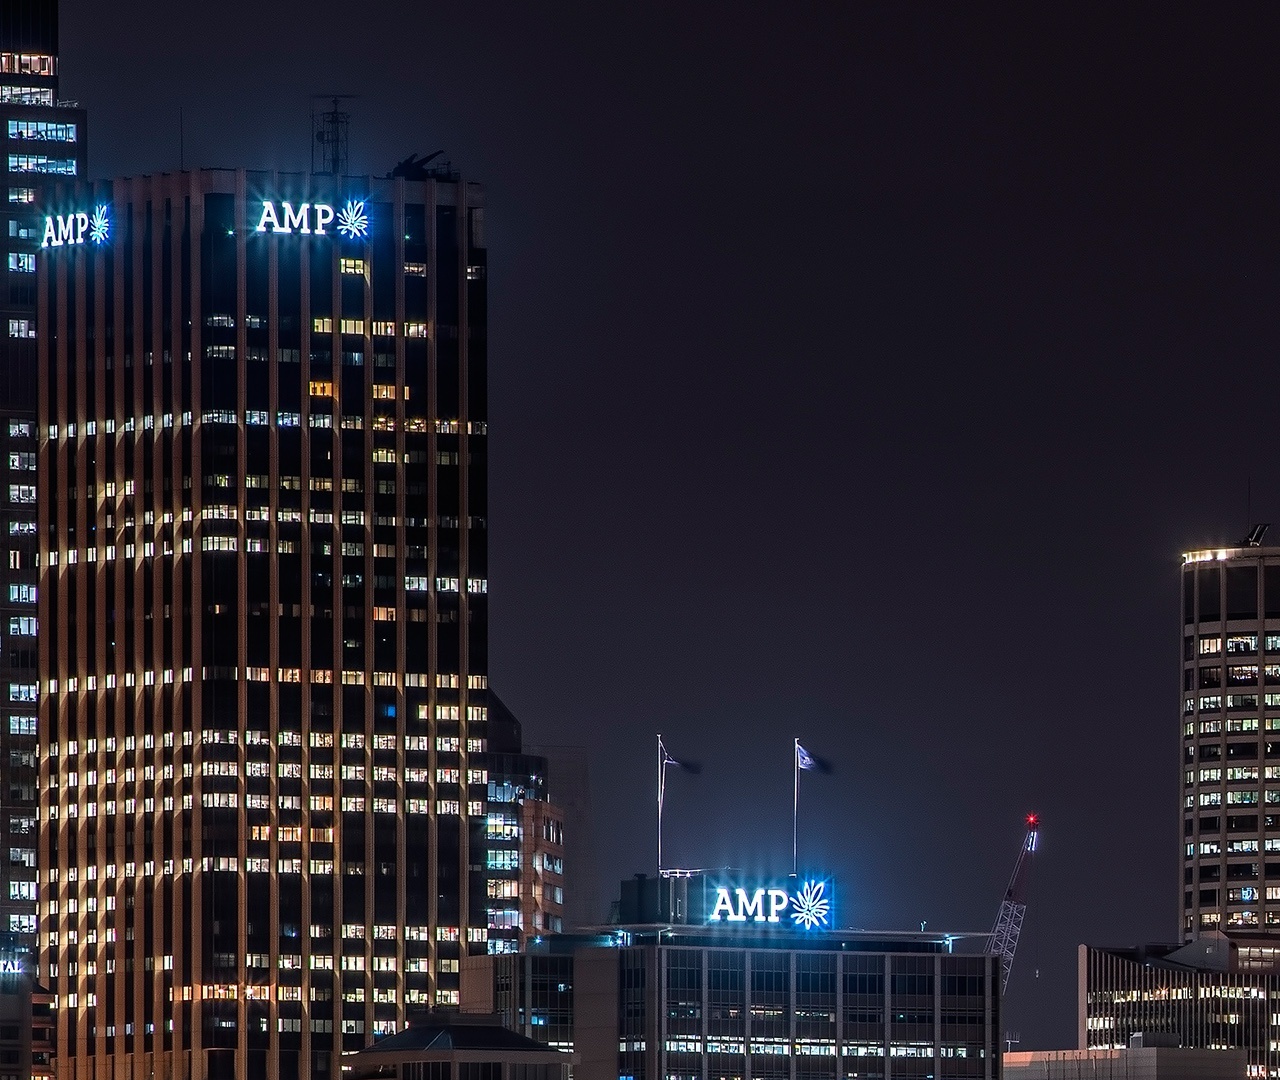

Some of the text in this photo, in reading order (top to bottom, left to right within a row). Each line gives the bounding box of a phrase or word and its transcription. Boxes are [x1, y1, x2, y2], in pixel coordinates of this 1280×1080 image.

[41, 211, 90, 248] AMP
[256, 200, 335, 236] AMP
[709, 887, 789, 923] AMP
